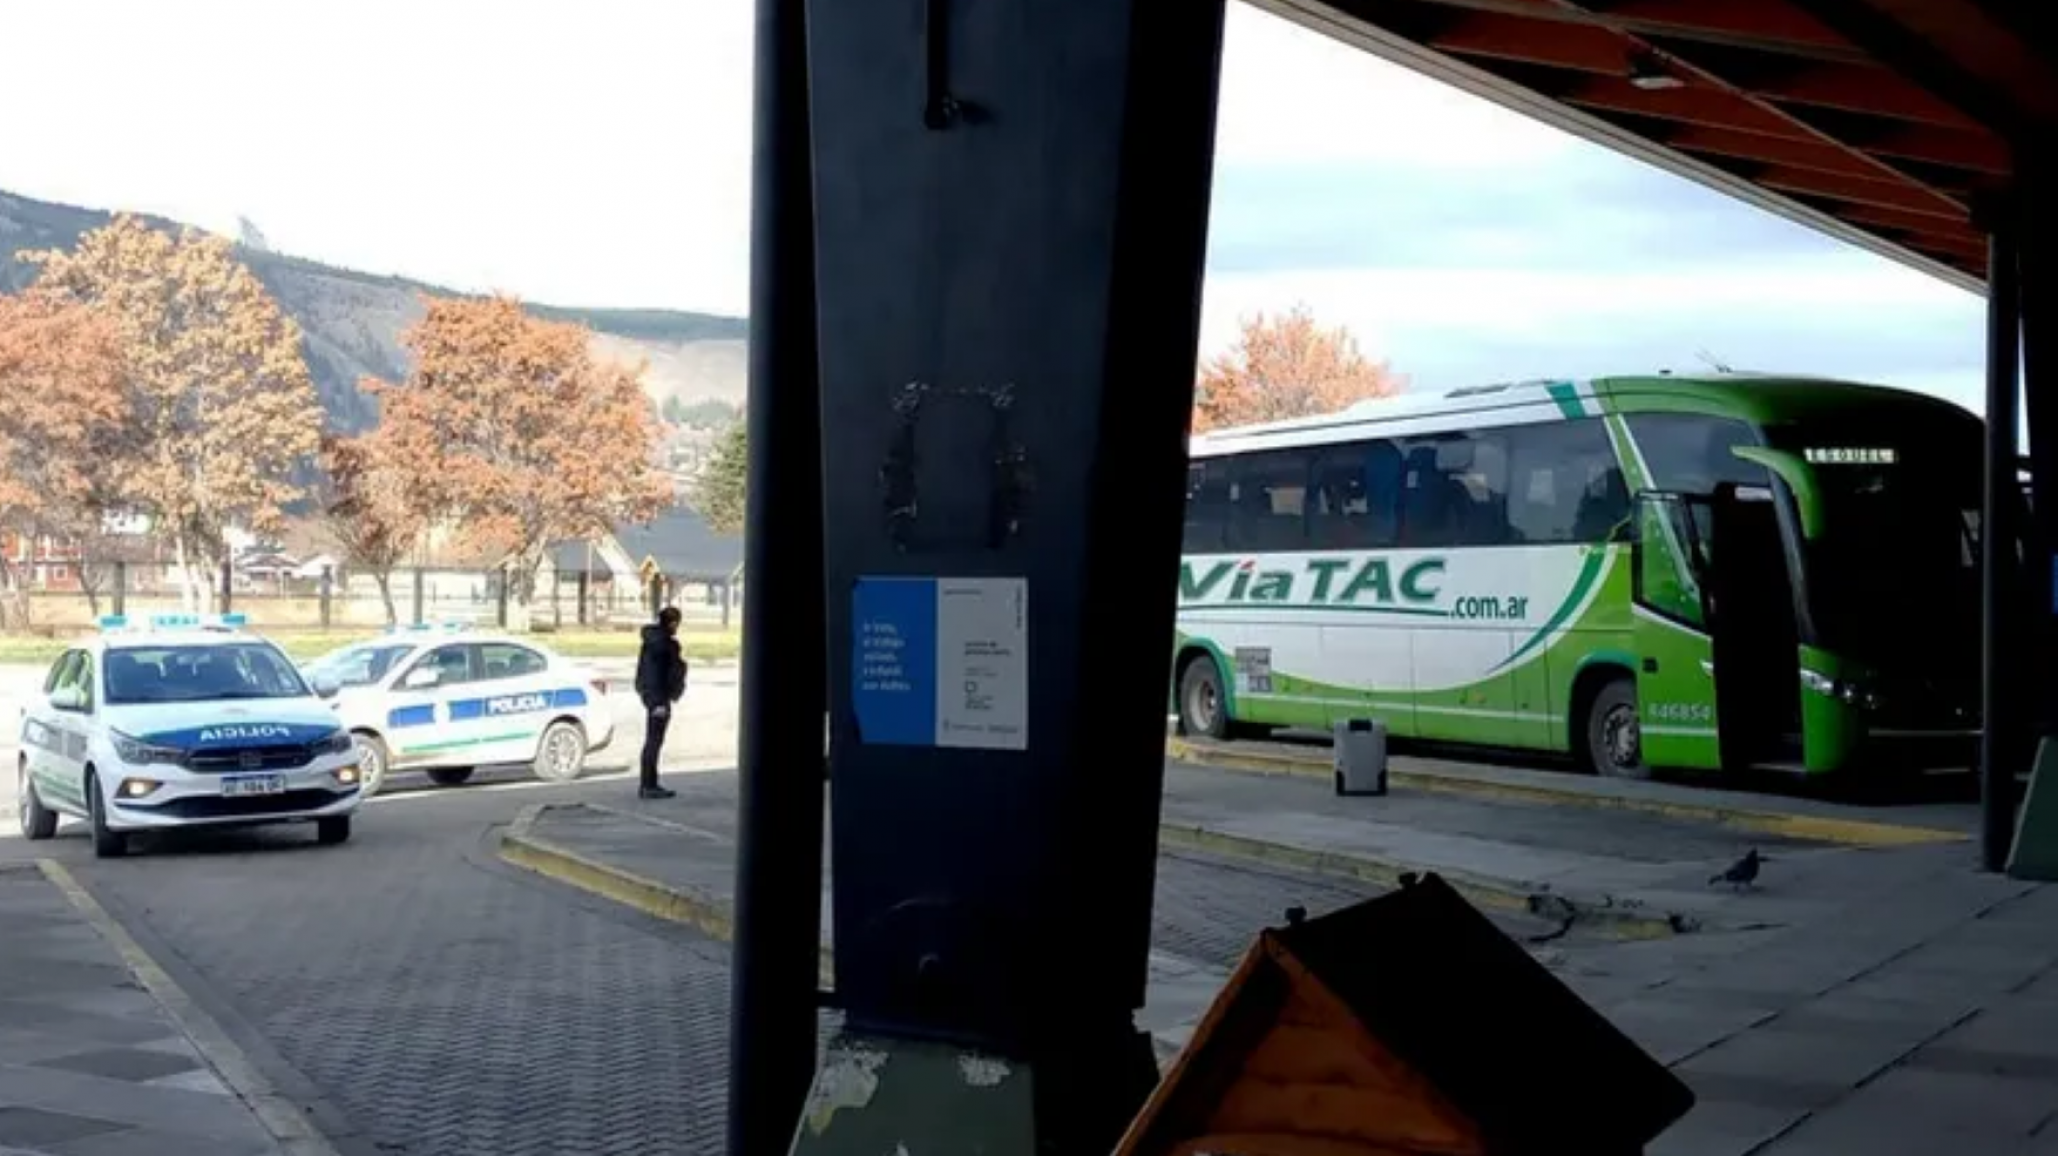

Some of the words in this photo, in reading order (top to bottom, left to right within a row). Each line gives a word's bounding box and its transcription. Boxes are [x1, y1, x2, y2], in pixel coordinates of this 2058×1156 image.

[1305, 557, 1445, 602] TAC
[1450, 595, 1529, 619] .com.ar
[486, 692, 546, 714] POLICIA
